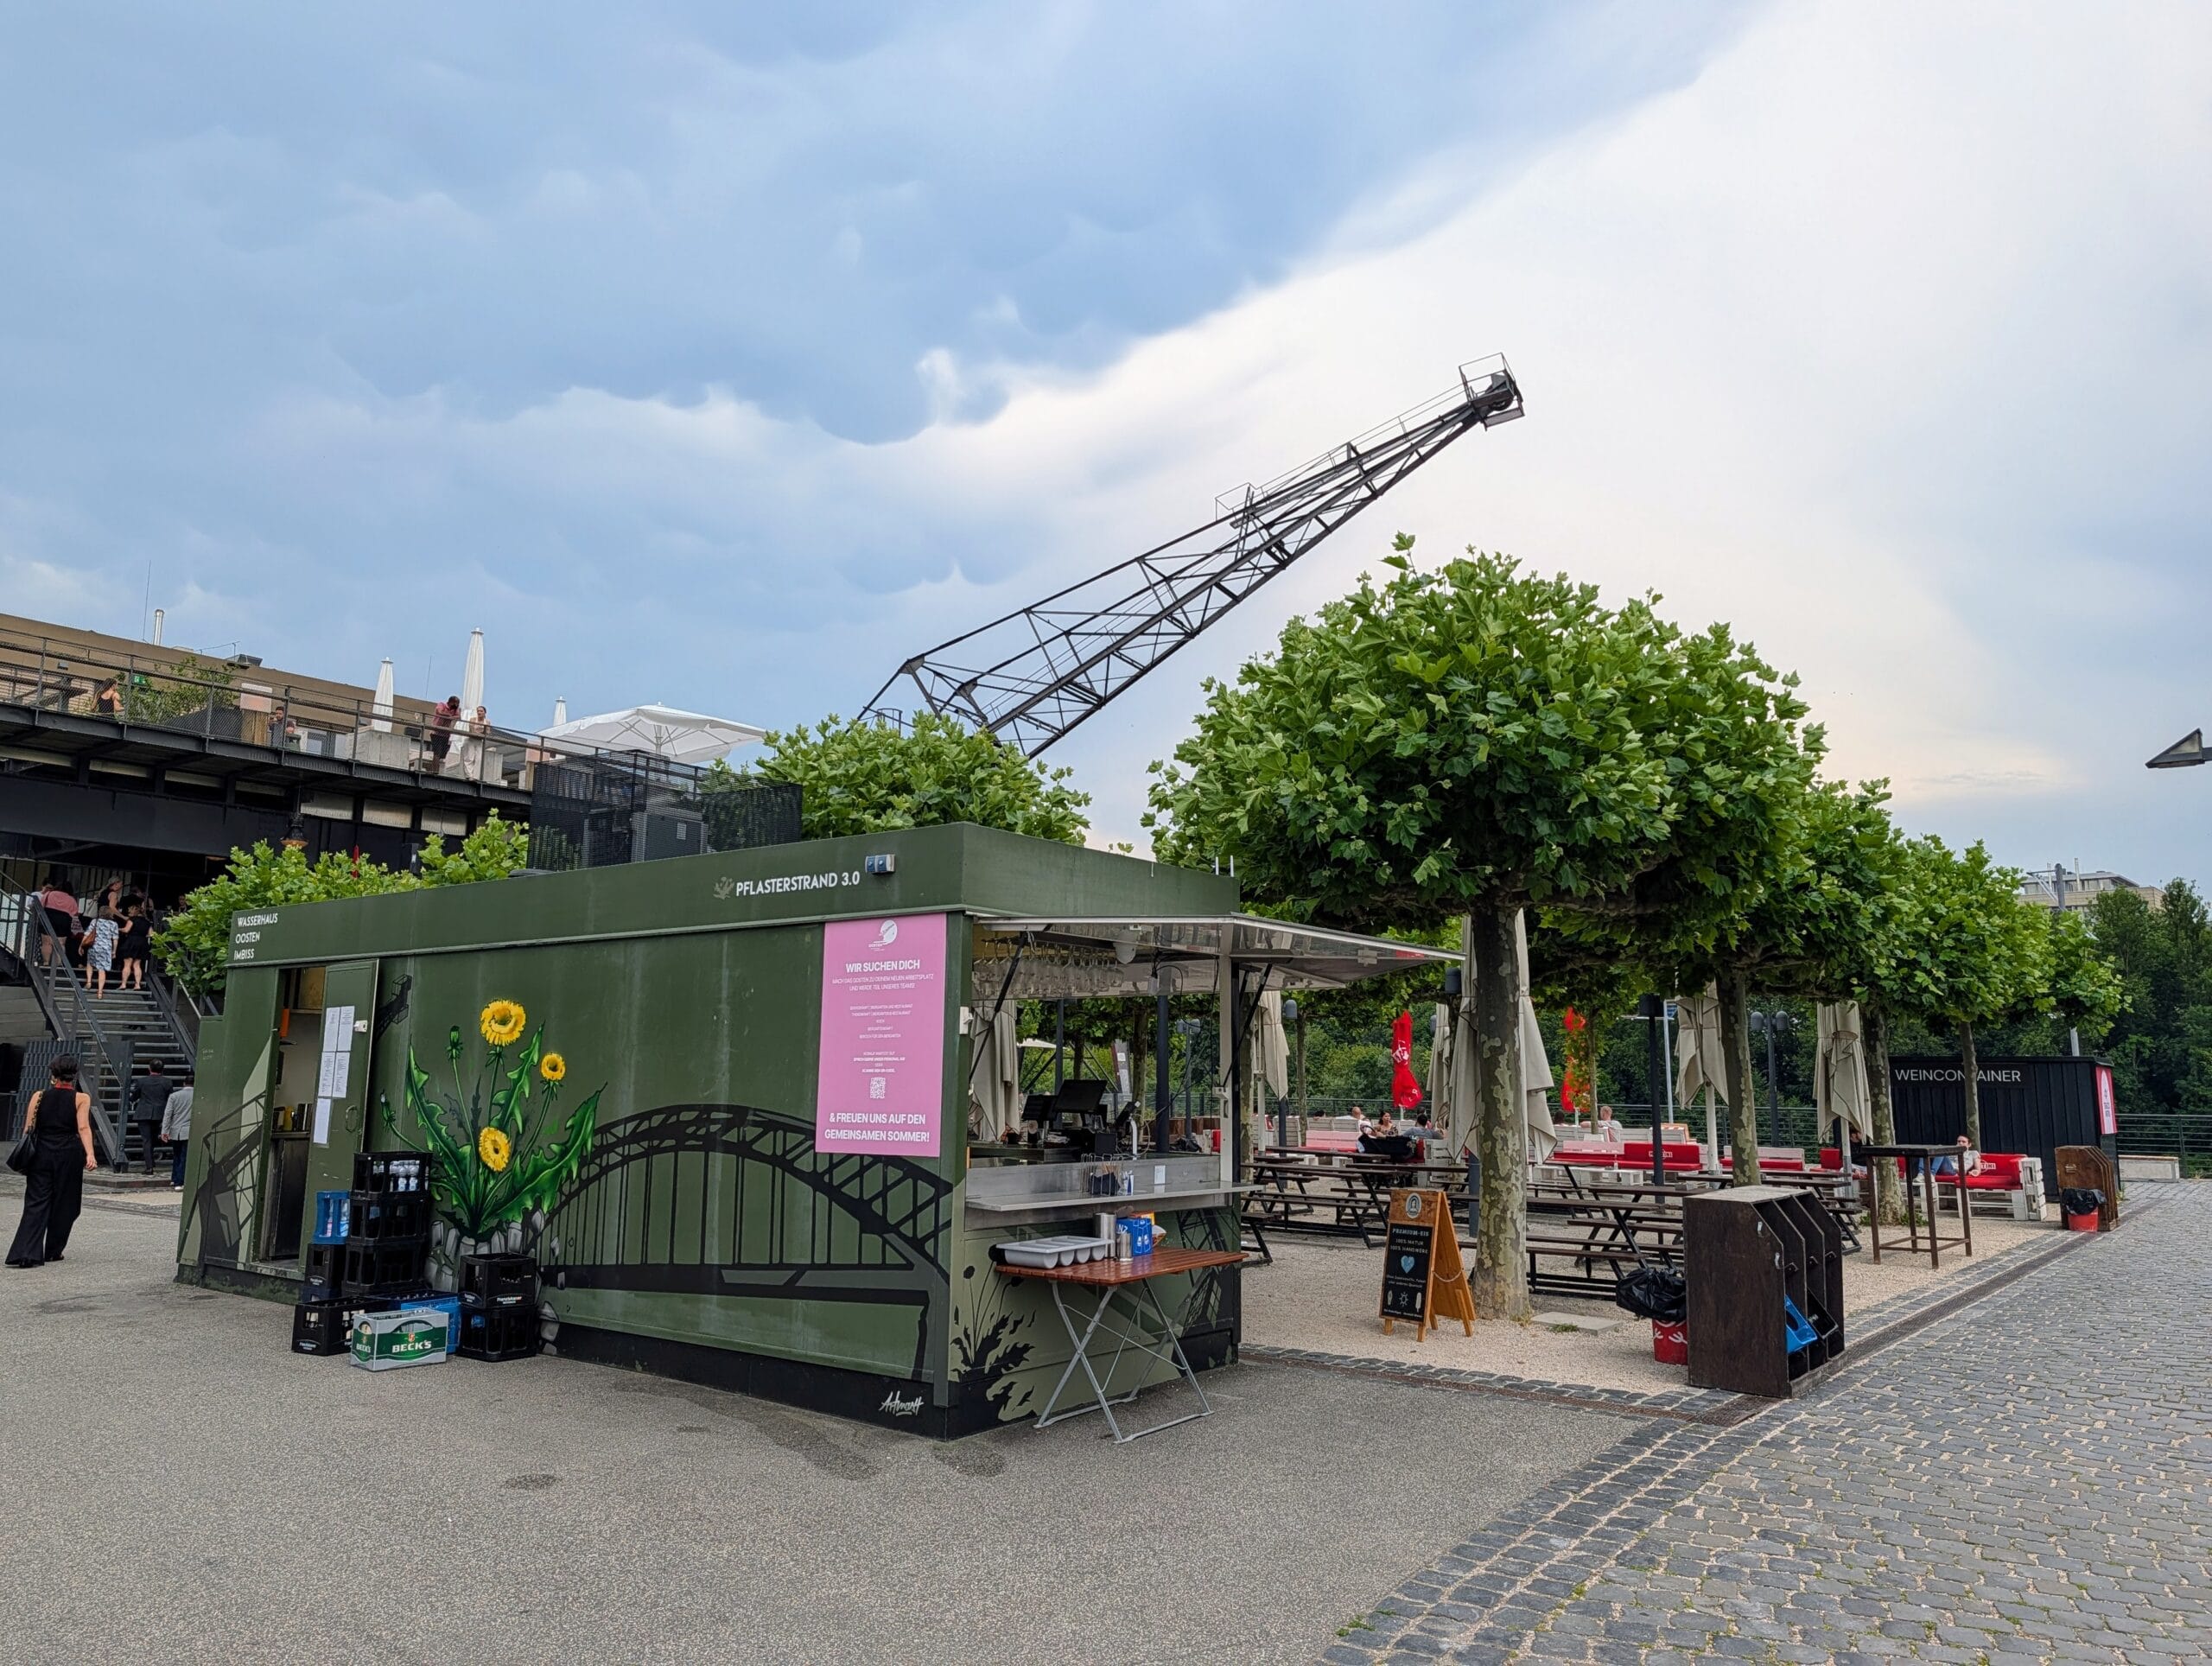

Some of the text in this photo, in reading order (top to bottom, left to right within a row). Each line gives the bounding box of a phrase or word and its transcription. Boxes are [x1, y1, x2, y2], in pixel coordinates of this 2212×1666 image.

[736, 871, 860, 897] PFLASTERSTRAND 3.0
[238, 912, 278, 927] WASSERHAUS
[235, 931, 260, 944] OOSTEN
[233, 949, 254, 961] IMBISS
[846, 959, 920, 973] WIR SUCHEN DICH
[1895, 1069, 2021, 1082] WEINCONAINER
[830, 1112, 925, 1124] & FREUEN UNS AUF DEN
[824, 1129, 930, 1142] GEMEINSAMEN SOMMER!
[356, 1343, 372, 1353] BECK'S
[391, 1339, 432, 1353] BECK'S
